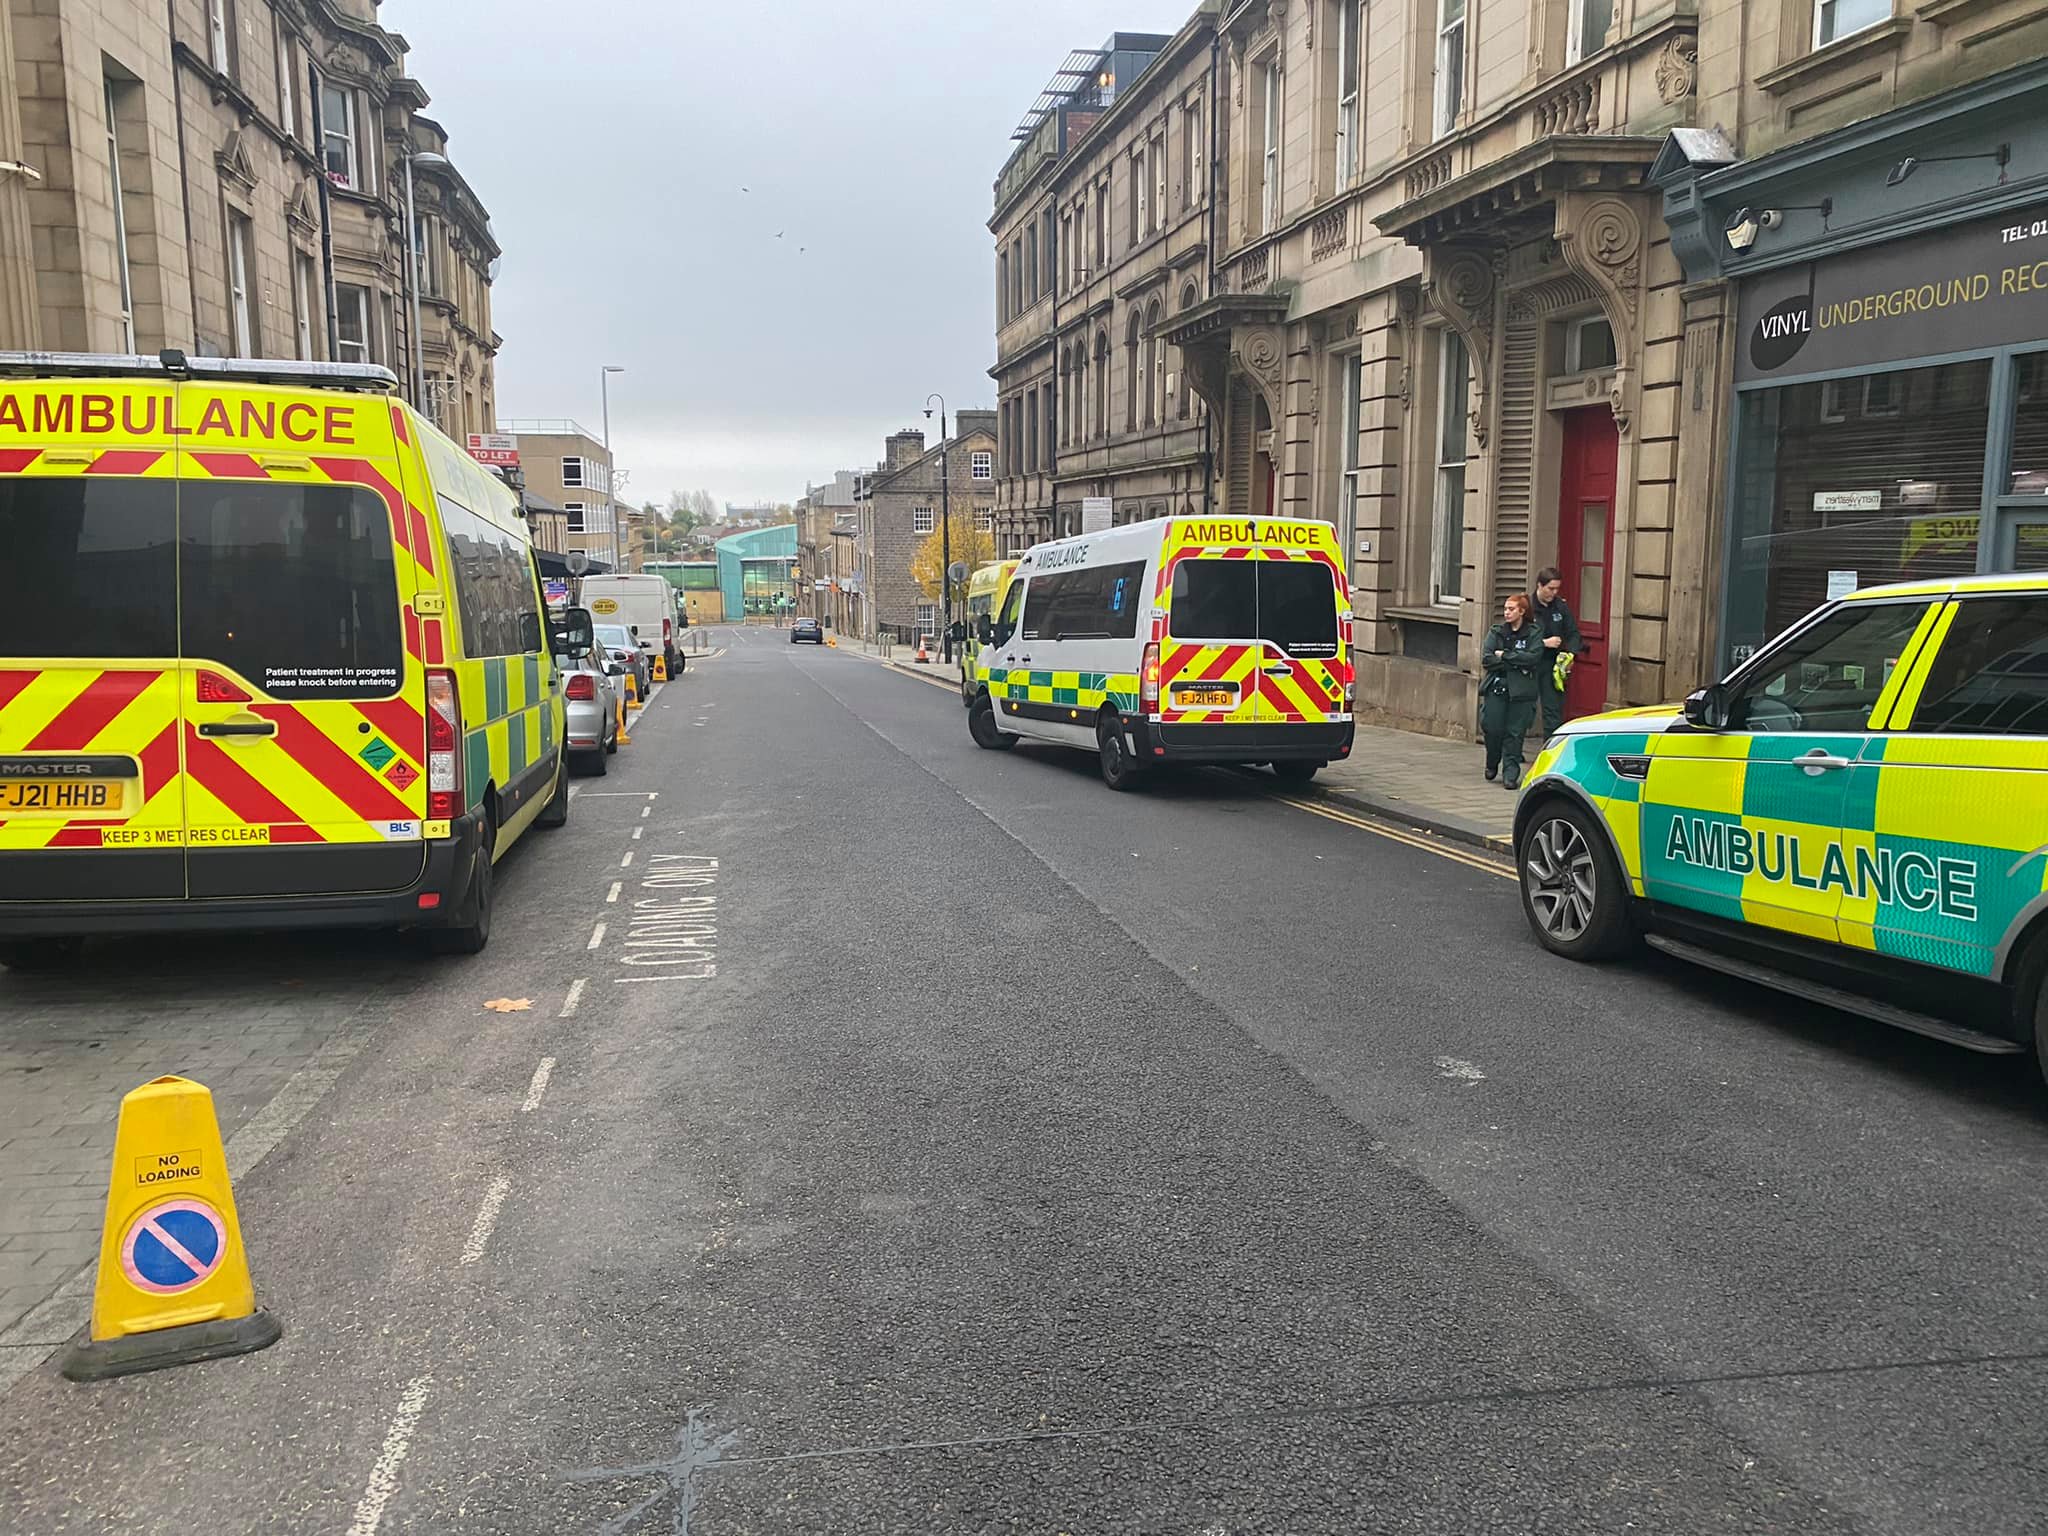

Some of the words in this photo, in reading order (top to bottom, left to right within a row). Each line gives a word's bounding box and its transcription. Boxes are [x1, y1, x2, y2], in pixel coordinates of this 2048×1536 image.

[2001, 225, 2028, 243] TEL:
[1761, 310, 1811, 339] VINYL
[1819, 274, 1990, 328] UNDERGROUND
[0, 394, 356, 445] AMBULANCE
[473, 450, 488, 459] TO
[491, 451, 511, 460] LET
[1182, 523, 1320, 545] AMBULANCE
[1036, 544, 1089, 570] AMBULANCE
[265, 668, 298, 676] Patient
[300, 668, 343, 676] treatment
[345, 668, 354, 676] in
[356, 668, 396, 677] progress
[266, 678, 296, 688] please
[298, 678, 326, 687] knock
[328, 678, 357, 687] before
[358, 678, 396, 687] entering
[2, 764, 92, 774] MASTER
[56, 784, 107, 806] HHB
[103, 831, 140, 843] KEEP
[144, 831, 151, 842] 3
[222, 828, 268, 841] CLEAR
[389, 822, 411, 832] BLS
[641, 854, 719, 888] ONLY
[1665, 814, 1977, 921] AMBULANCE
[614, 896, 718, 983] LOADING
[158, 1155, 180, 1167] NO
[138, 1166, 200, 1183] LOADING
